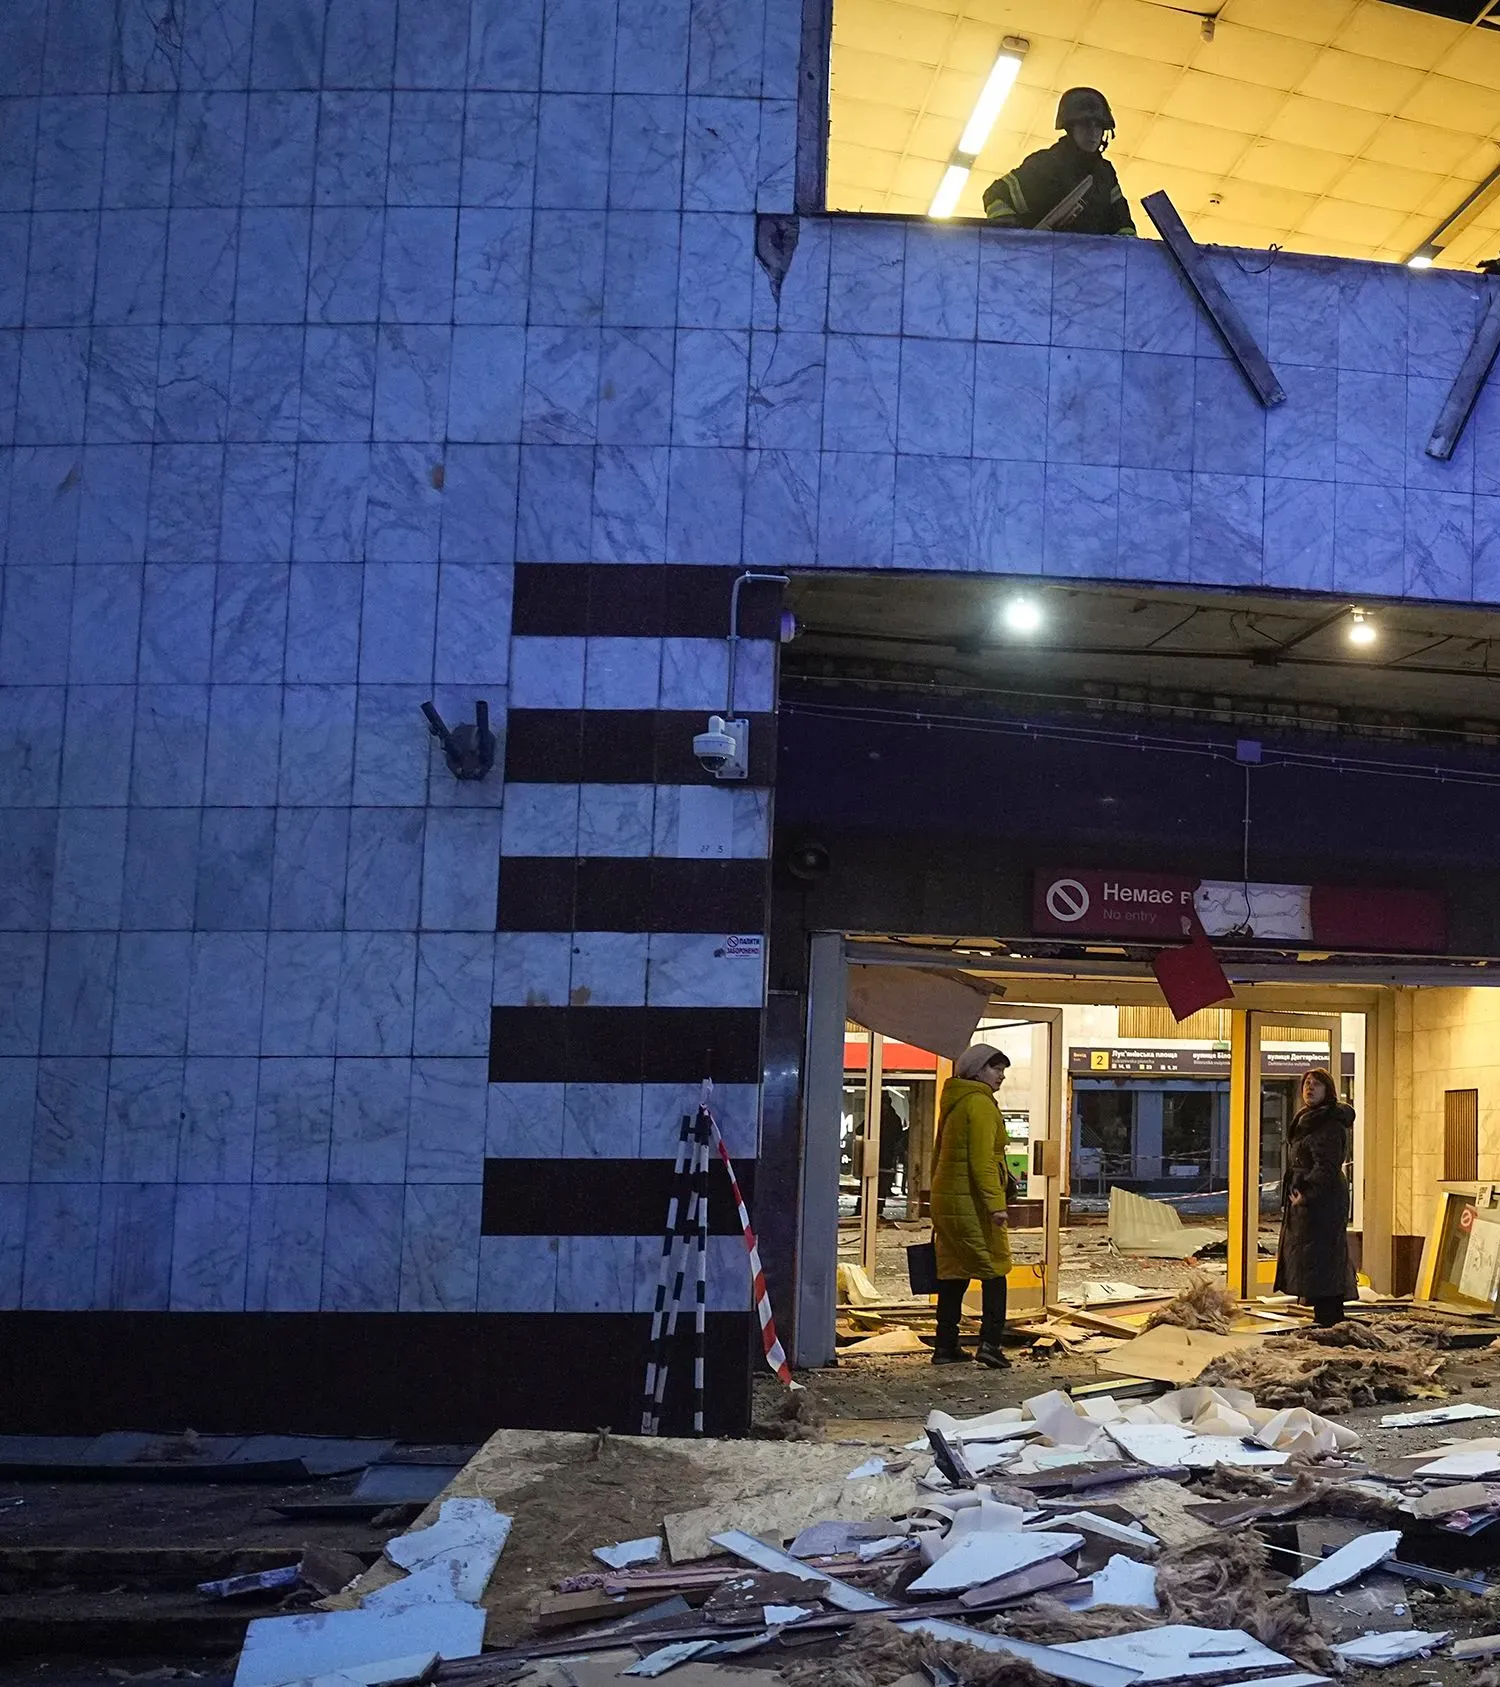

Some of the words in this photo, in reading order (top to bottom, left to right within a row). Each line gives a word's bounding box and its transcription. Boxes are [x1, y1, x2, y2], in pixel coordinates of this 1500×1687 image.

[1103, 882, 1174, 904] Немає
[1103, 909, 1121, 921] No
[1125, 909, 1157, 923] entry
[1096, 1055, 1104, 1066] 2
